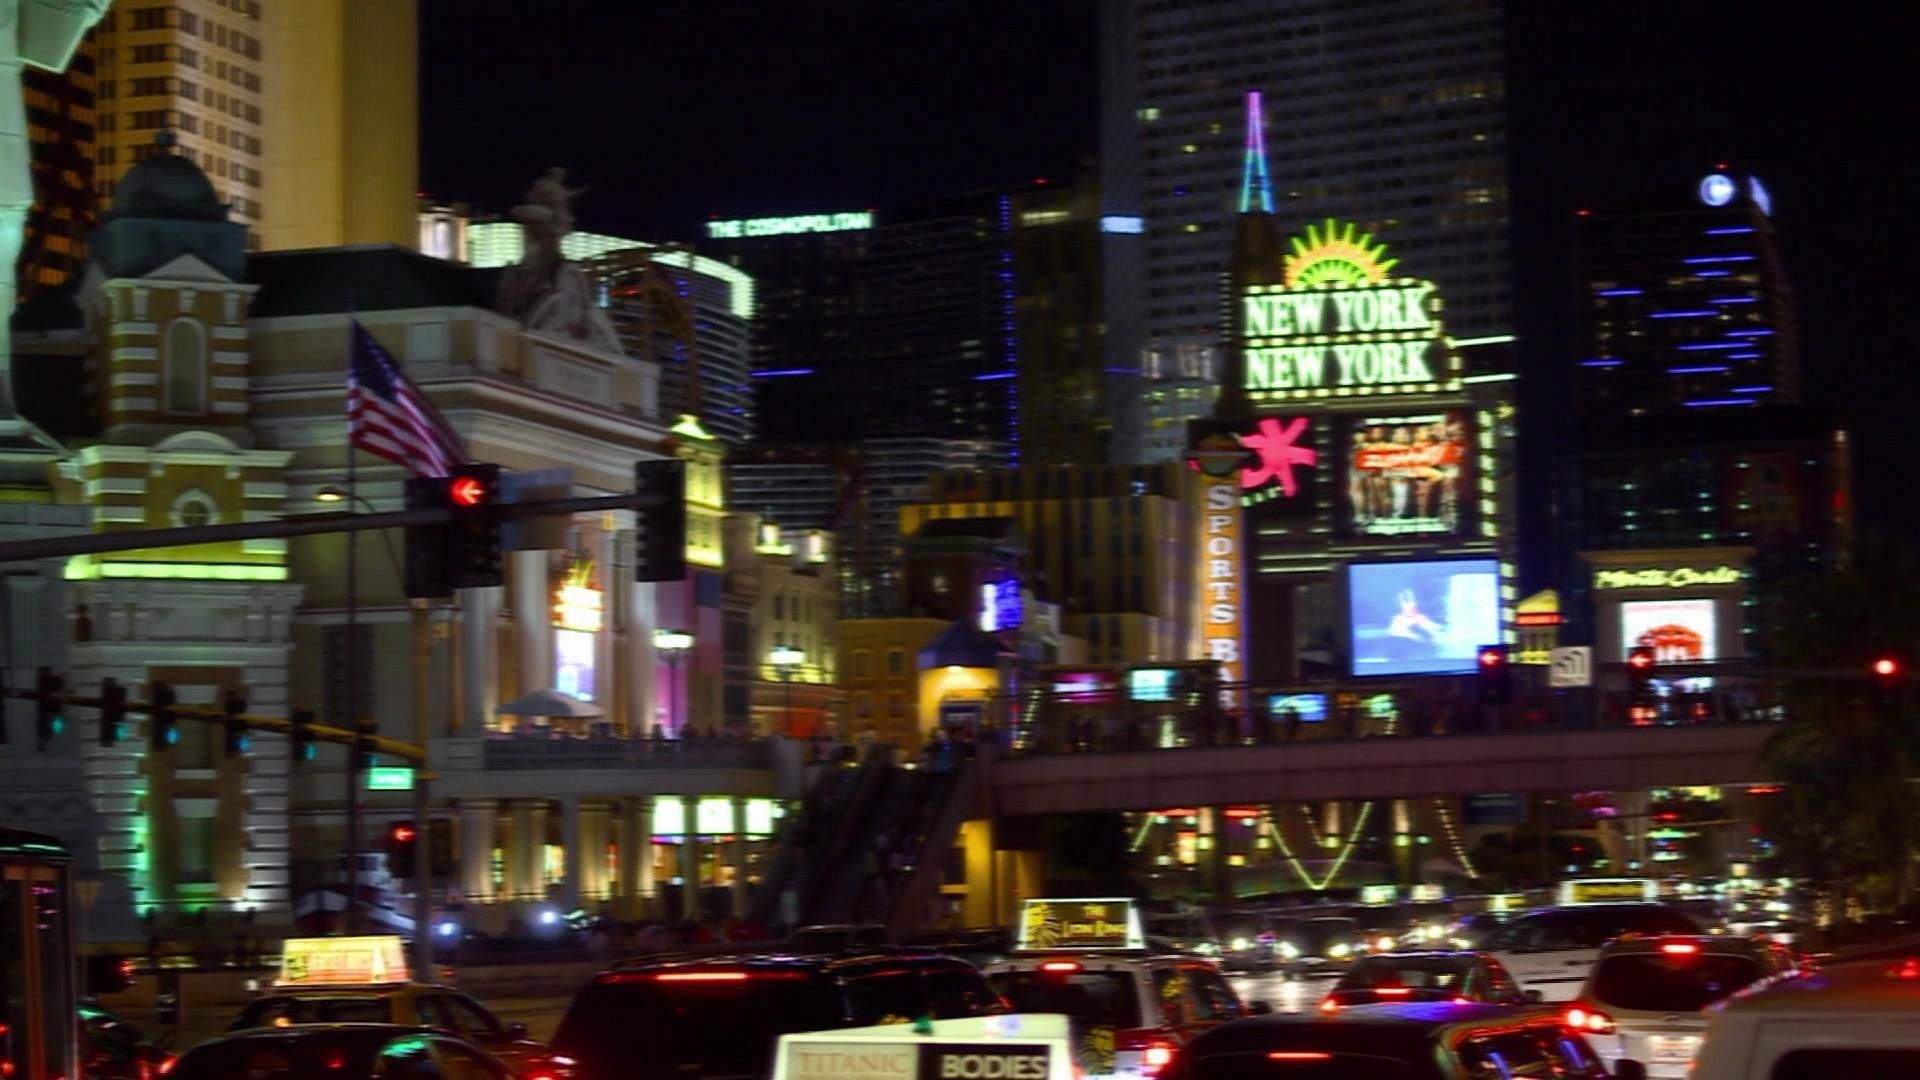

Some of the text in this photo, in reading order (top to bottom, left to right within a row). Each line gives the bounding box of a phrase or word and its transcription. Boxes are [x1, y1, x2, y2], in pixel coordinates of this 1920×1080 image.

[706, 212, 873, 238] THE COSMOPOLITAN
[1244, 287, 1432, 337] NEW YORK
[1244, 340, 1433, 390] NEW YORK
[1207, 484, 1236, 625] SPORTS
[801, 1053, 908, 1074] TITANIC
[942, 1055, 1046, 1079] BODIES
